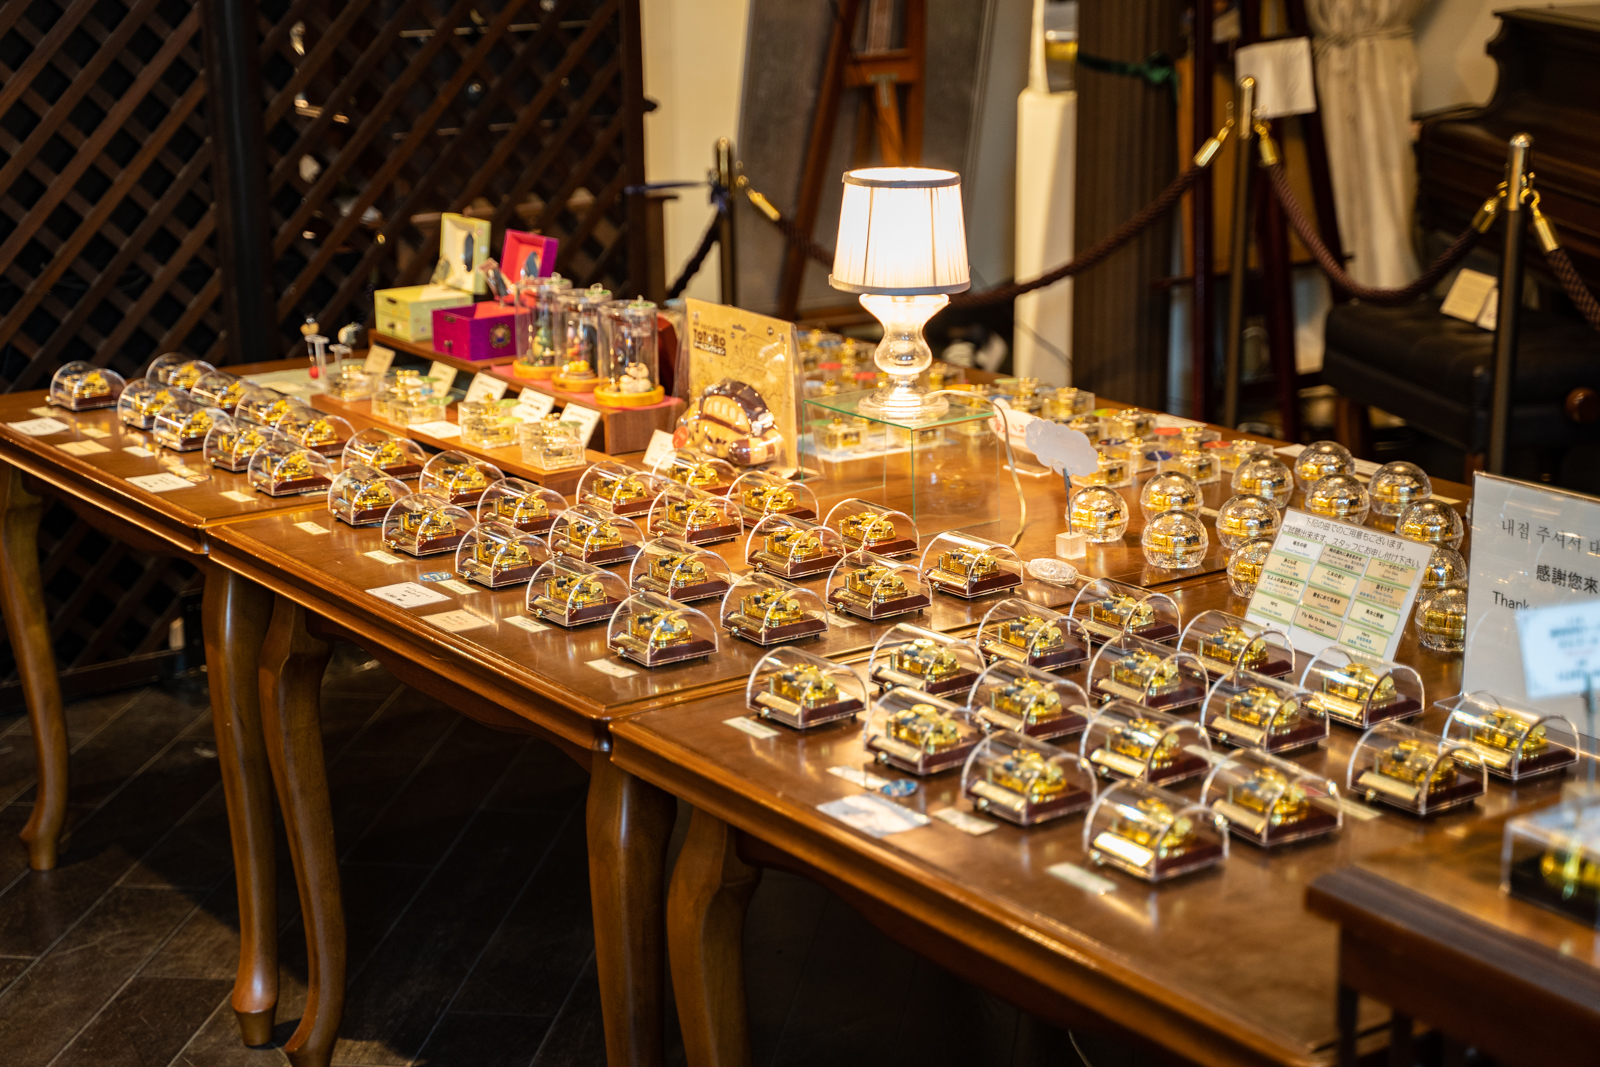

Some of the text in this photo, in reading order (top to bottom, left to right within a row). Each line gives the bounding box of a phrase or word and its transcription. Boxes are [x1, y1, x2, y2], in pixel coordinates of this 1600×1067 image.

[1501, 518, 1530, 540] 내점
[1535, 525, 1582, 553] 주셔서
[1492, 590, 1530, 611] Thank
